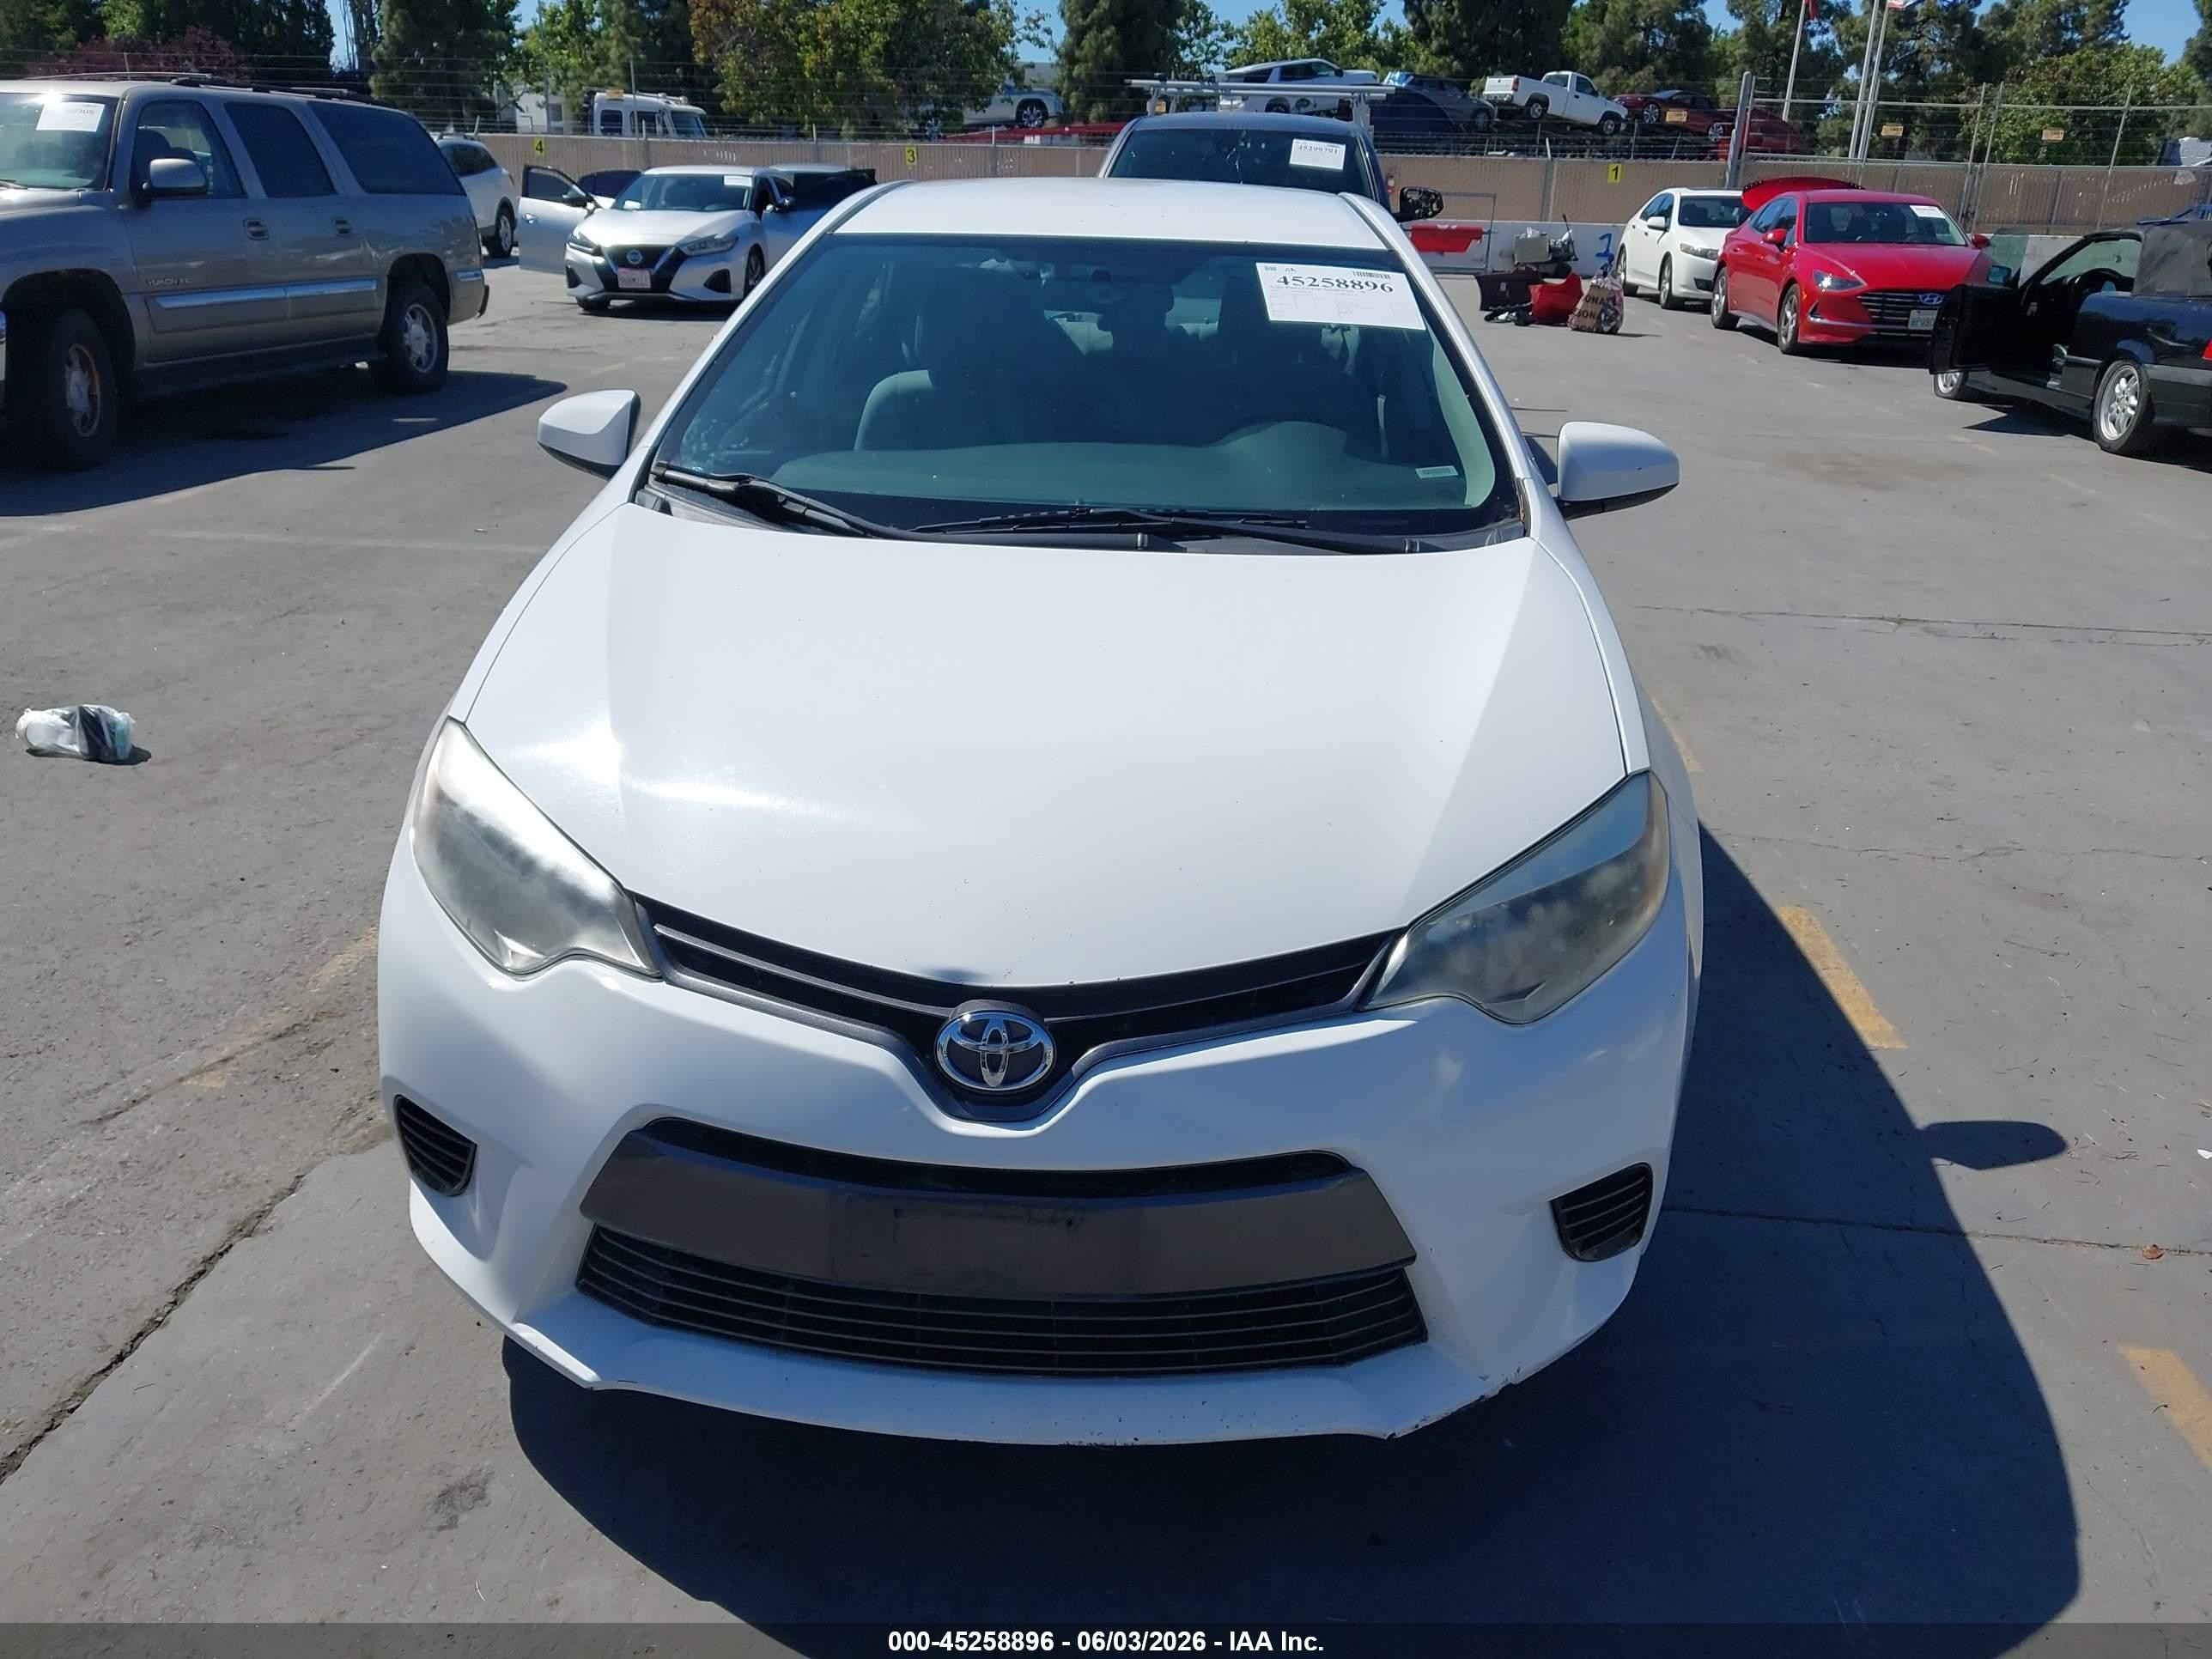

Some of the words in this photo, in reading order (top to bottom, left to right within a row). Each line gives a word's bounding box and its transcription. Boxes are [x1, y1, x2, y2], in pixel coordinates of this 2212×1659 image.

[535, 139, 544, 154] 4
[907, 149, 915, 163] 3
[1612, 166, 1620, 180] 1
[1276, 275, 1394, 293] 45258896
